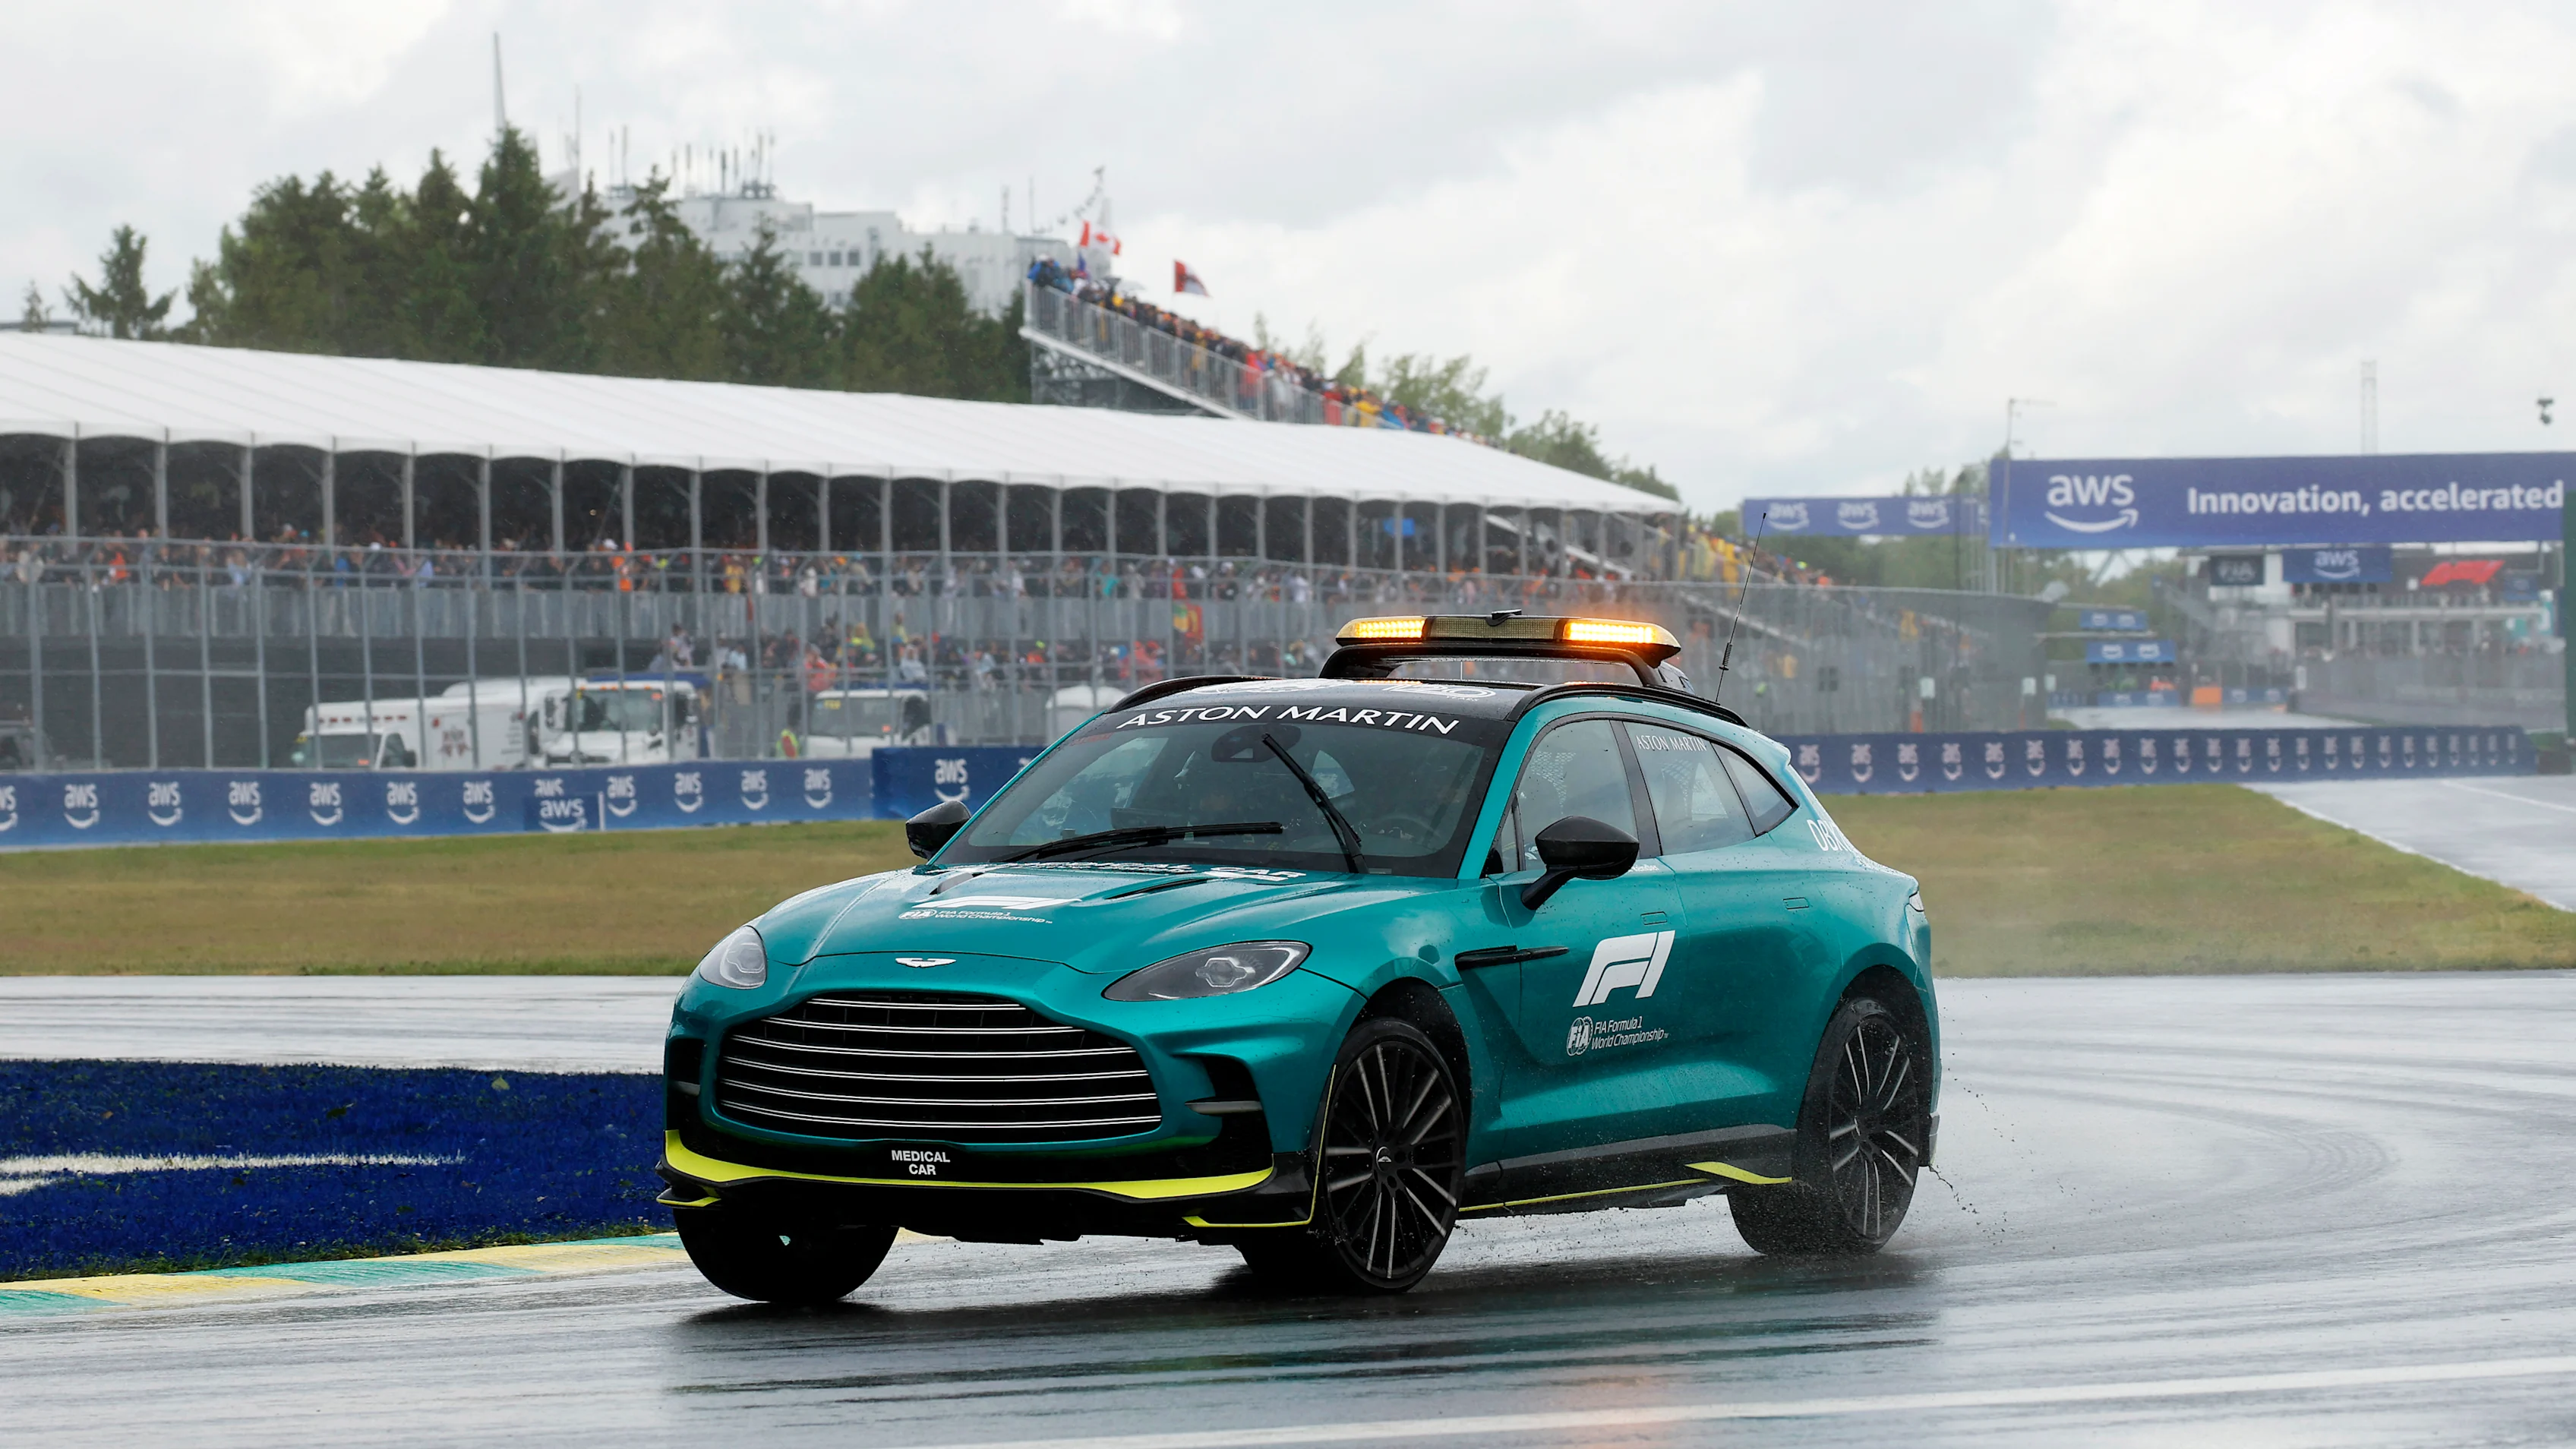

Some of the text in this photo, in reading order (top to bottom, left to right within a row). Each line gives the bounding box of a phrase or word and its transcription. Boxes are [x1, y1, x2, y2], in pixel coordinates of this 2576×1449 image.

[2047, 474, 2135, 507] aws
[2188, 479, 2564, 516] Innovation, accelerated
[2315, 549, 2360, 569] aws
[1116, 705, 1460, 735] ASTON MARTIN
[1636, 734, 1707, 752] ASTON MARTIN
[935, 758, 968, 784] aws
[64, 783, 98, 809] aws
[148, 781, 181, 807] aws
[229, 781, 261, 807] aws
[309, 782, 342, 807] aws
[387, 781, 418, 806] aws
[462, 780, 494, 805] aws
[540, 798, 585, 819] aws
[901, 910, 933, 919] FIA
[1593, 1020, 1607, 1034] FIA
[1607, 1016, 1638, 1033] Formula
[1591, 1033, 1615, 1050] World
[892, 1150, 951, 1163] MEDICAL
[908, 1163, 936, 1176] CAR
